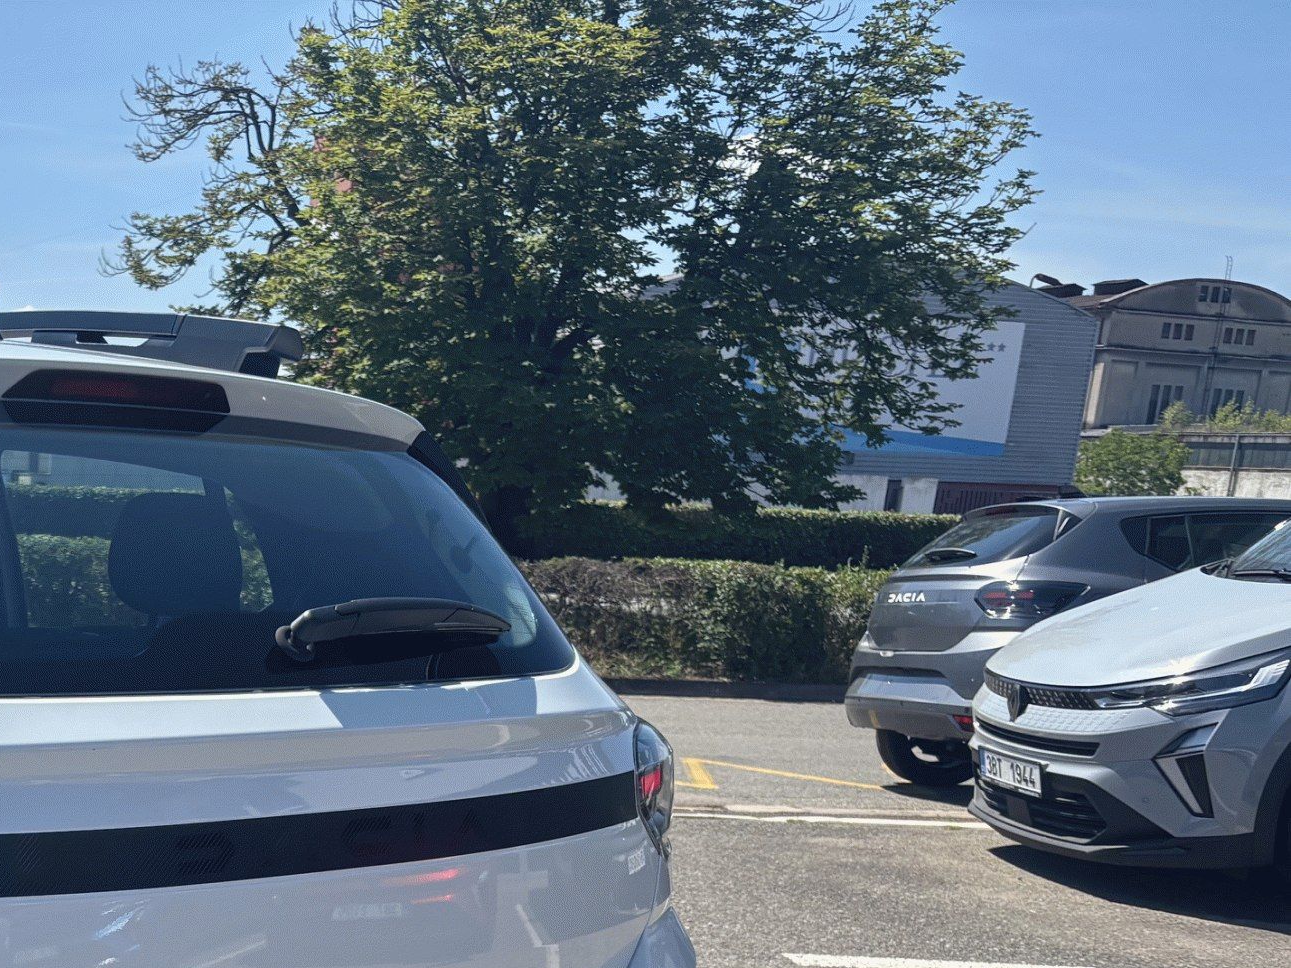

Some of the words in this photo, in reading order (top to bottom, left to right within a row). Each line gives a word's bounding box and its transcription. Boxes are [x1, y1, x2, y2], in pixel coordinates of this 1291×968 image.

[887, 592, 926, 604] DACIA
[986, 754, 1003, 779] 3BT
[1009, 761, 1037, 789] 1944
[174, 807, 489, 876] DCIA
